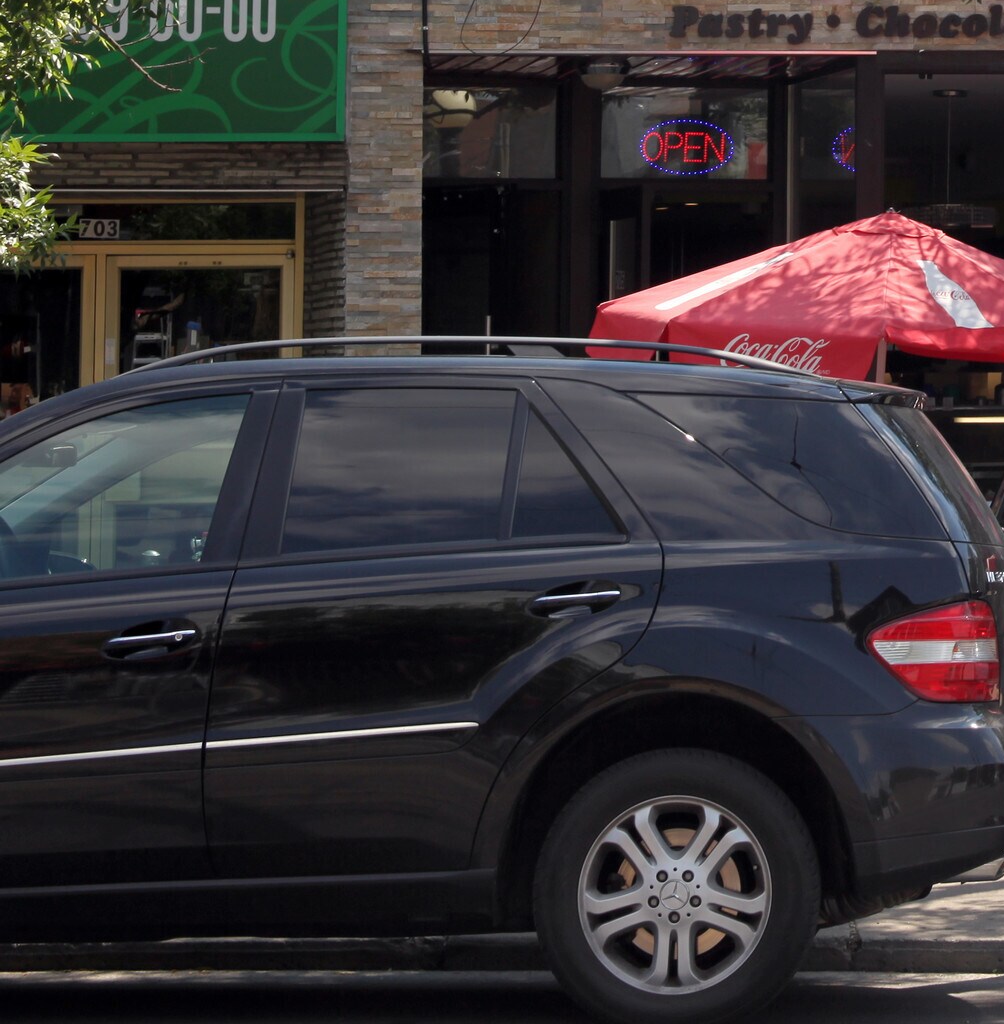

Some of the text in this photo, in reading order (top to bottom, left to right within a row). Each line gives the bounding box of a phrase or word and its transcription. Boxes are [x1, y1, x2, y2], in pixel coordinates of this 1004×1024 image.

[669, 5, 814, 45] Pastry
[642, 131, 726, 163] OPEN
[80, 219, 118, 237] 703
